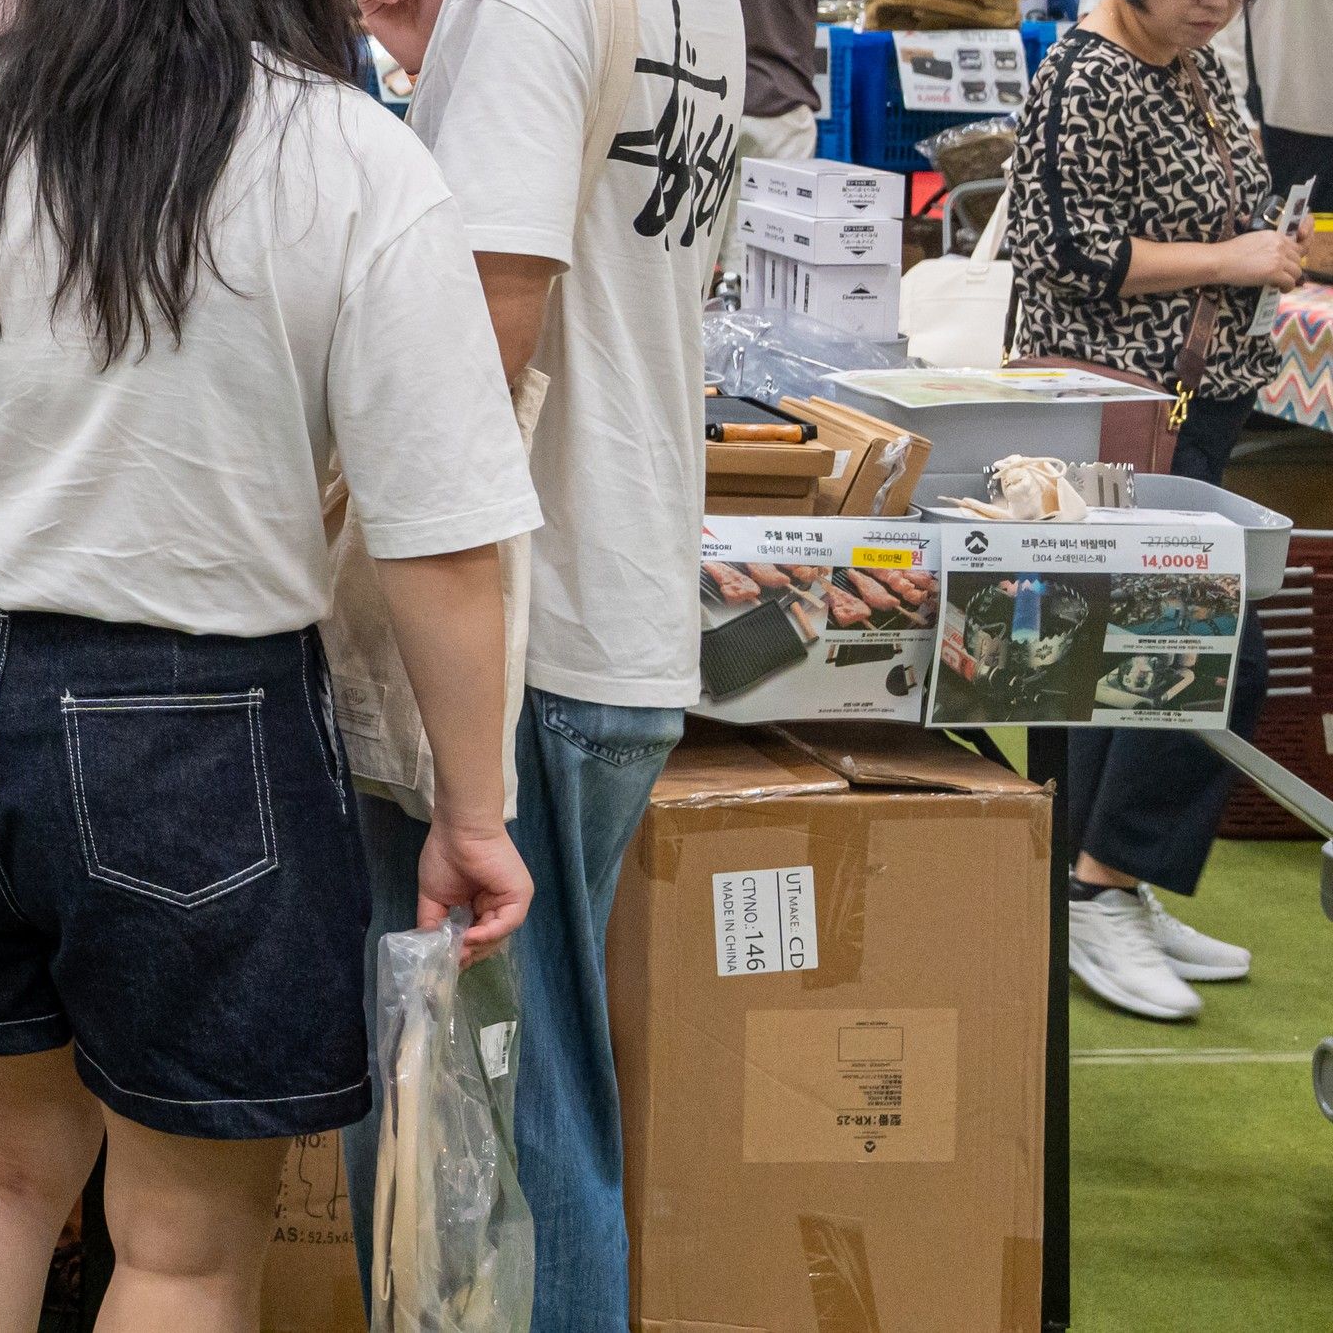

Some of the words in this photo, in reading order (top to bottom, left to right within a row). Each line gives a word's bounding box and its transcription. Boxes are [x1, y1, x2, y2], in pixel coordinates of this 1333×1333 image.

[764, 530, 783, 541] 주철
[1021, 538, 1057, 550] 브루스타
[1140, 553, 1210, 570] 14,000원
[722, 881, 735, 916] MADE
[724, 919, 735, 932] IN
[725, 935, 737, 973] CHINA
[745, 930, 766, 971] 146
[789, 936, 805, 969] CD
[273, 1226, 304, 1243] AS:
